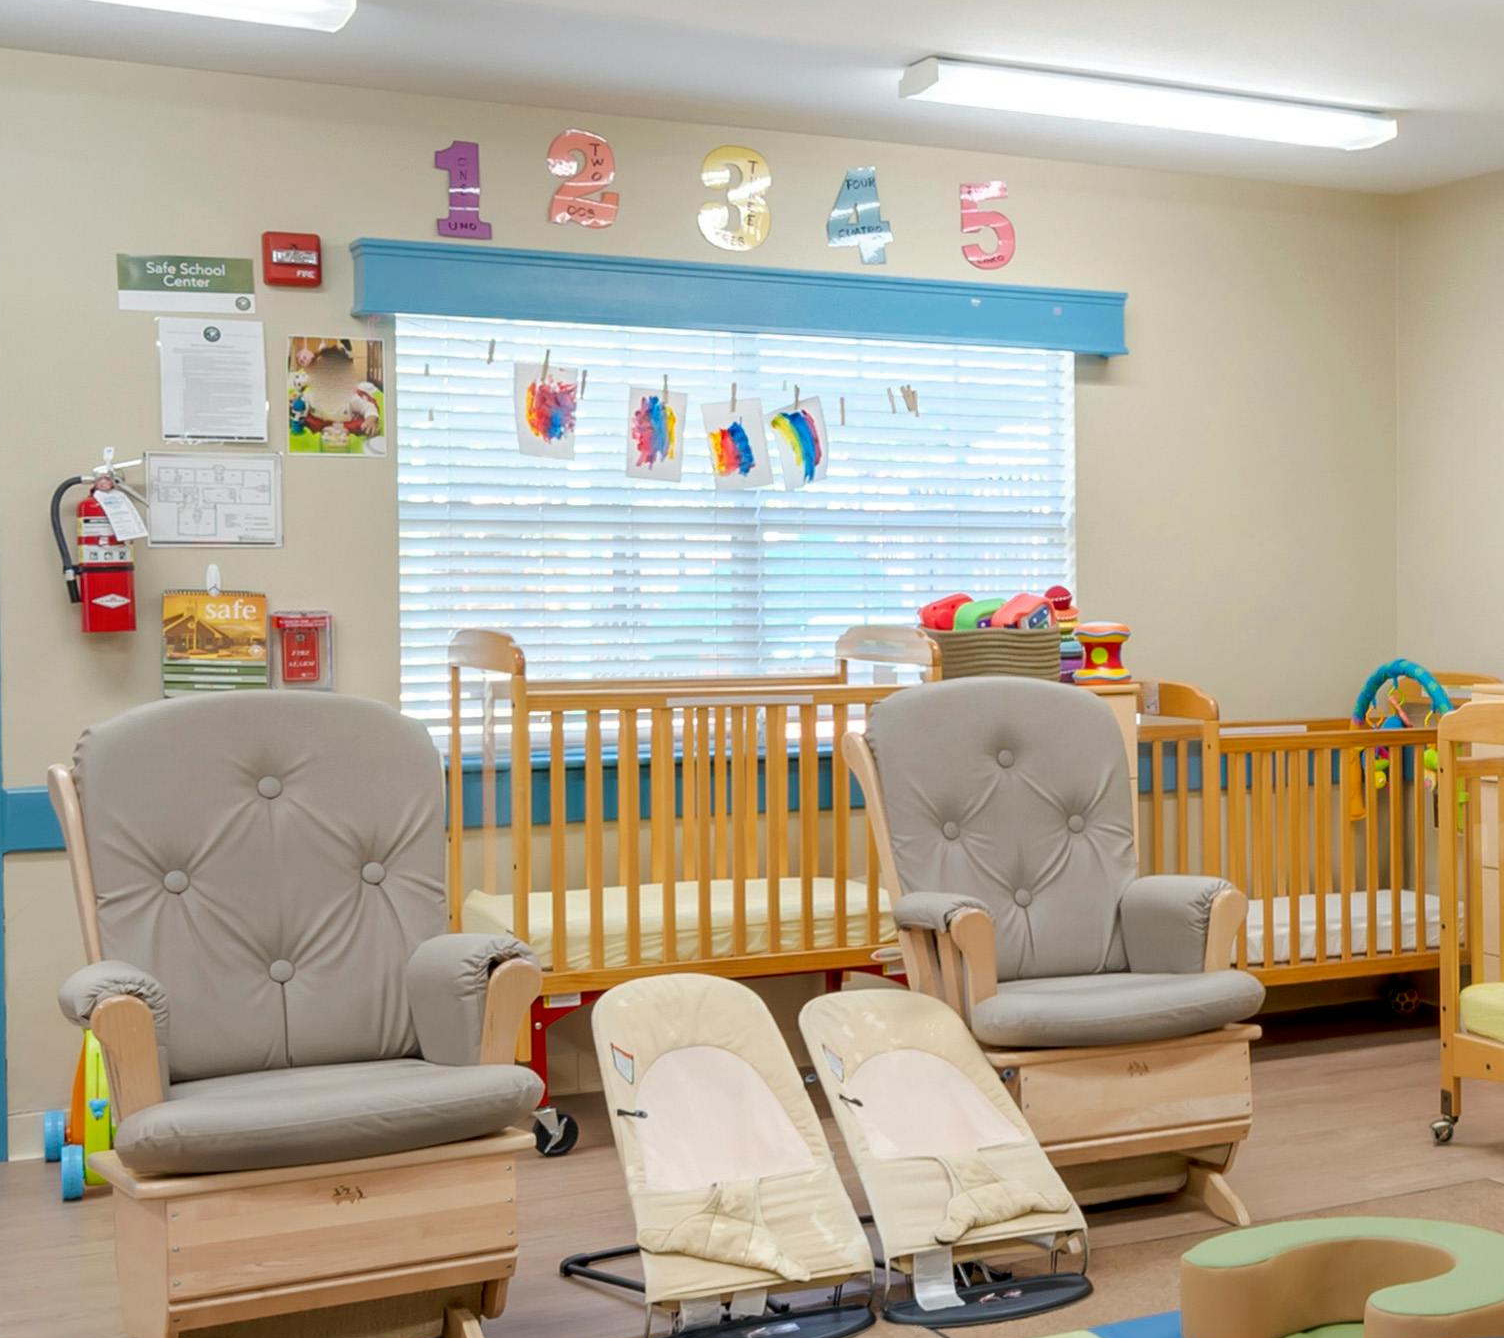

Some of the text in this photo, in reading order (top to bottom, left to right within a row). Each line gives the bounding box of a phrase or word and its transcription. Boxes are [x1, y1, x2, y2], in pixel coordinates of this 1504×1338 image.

[589, 142, 604, 182] TWO
[434, 140, 492, 240] 1
[845, 176, 877, 191] FOUR
[566, 204, 596, 219] DOS
[827, 165, 894, 265] 4
[448, 221, 478, 232] UNO
[960, 180, 1017, 271] 5
[146, 262, 226, 276] Safe School
[163, 275, 210, 288] Center
[205, 599, 257, 620] safe
